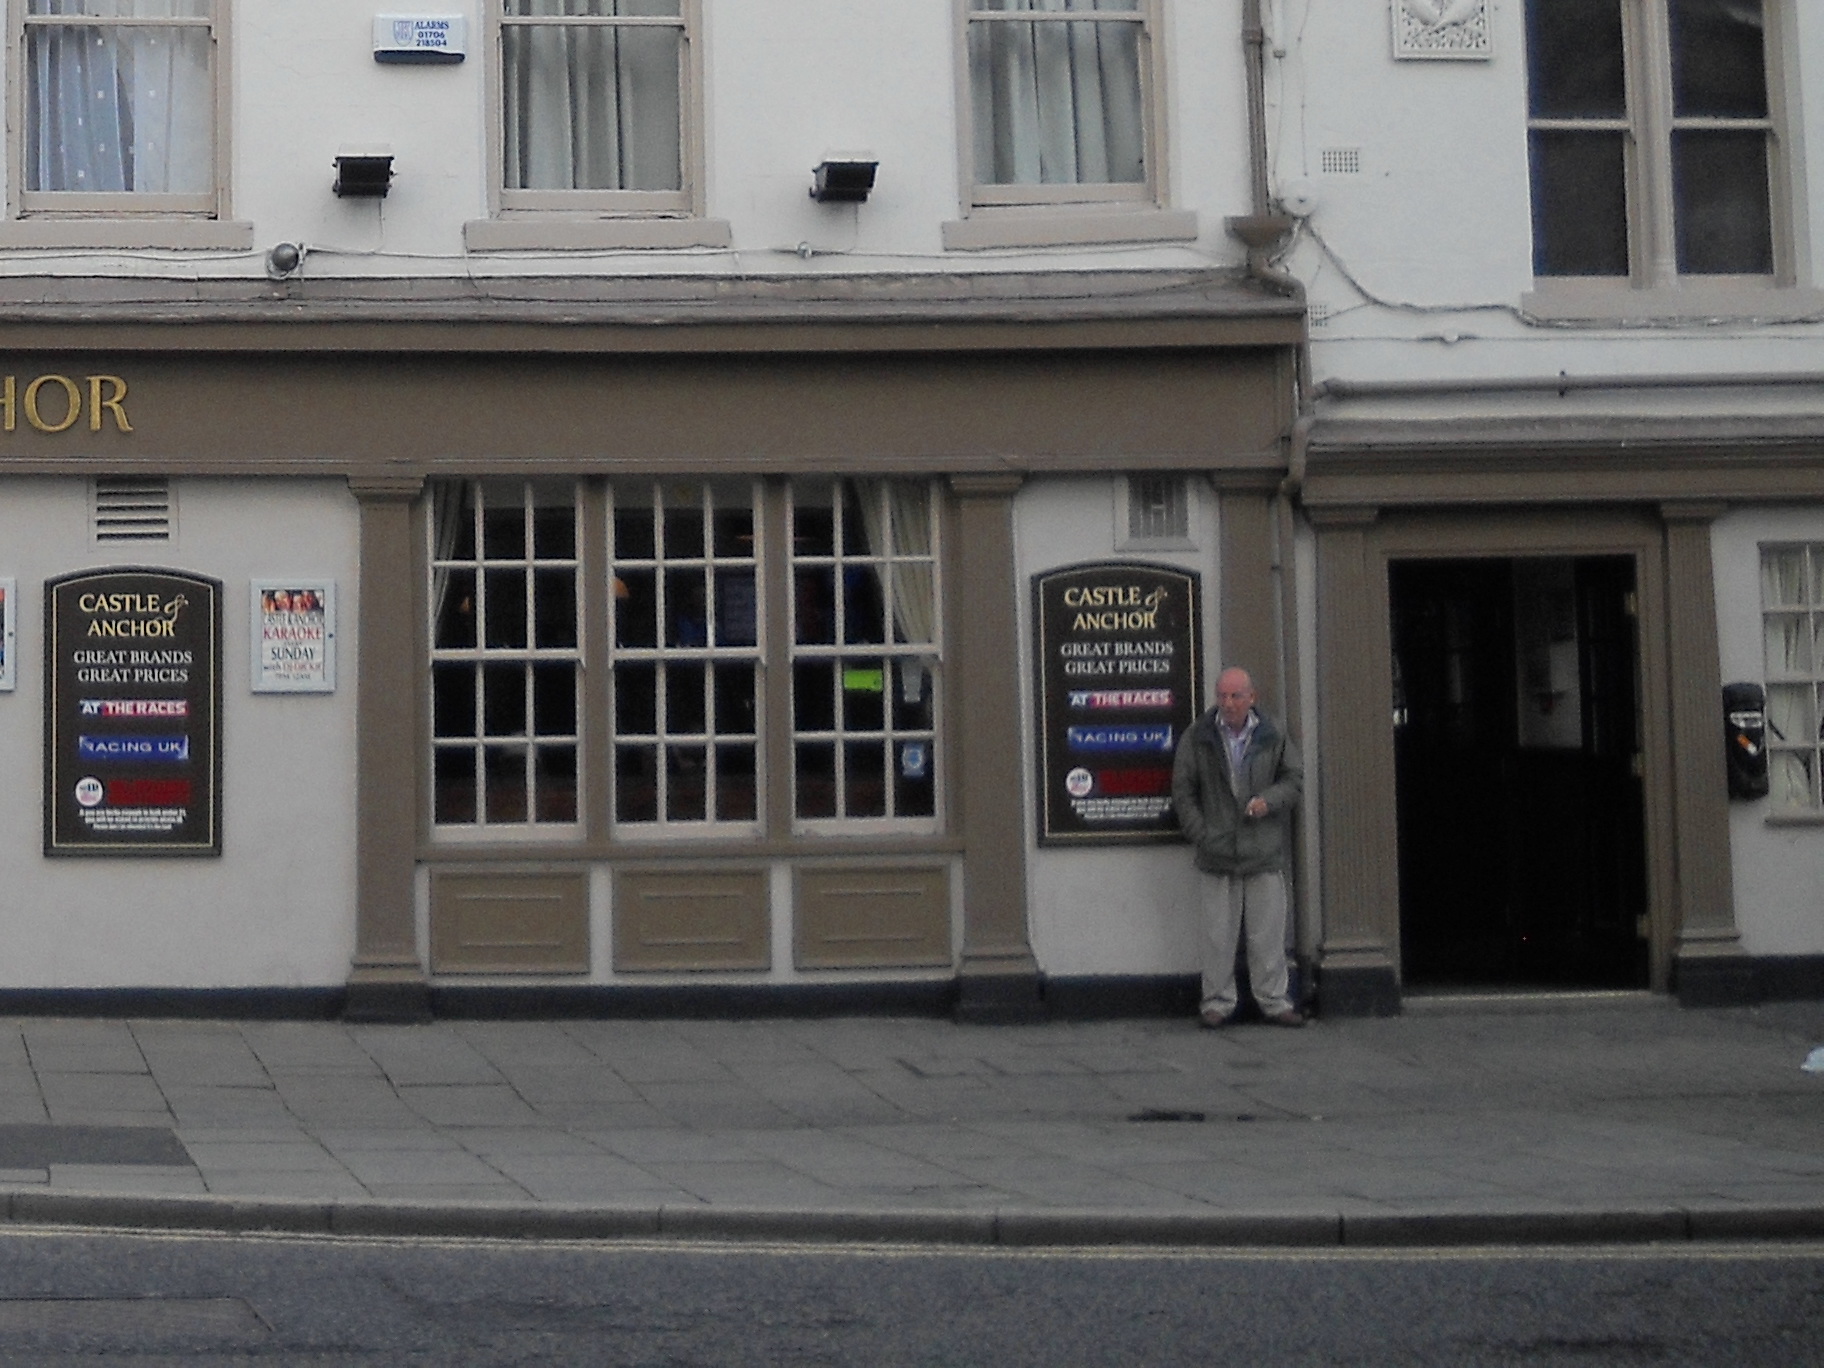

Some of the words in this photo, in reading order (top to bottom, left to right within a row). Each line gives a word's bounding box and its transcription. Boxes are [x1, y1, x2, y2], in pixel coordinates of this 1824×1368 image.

[415, 21, 449, 30] ALARMS
[418, 31, 445, 39] 01706
[1064, 586, 1141, 606] CASTLE
[1143, 585, 1168, 613] &
[79, 593, 160, 612] CASTLE
[162, 593, 189, 624] &
[87, 619, 175, 637] ANCHOR
[1073, 612, 1156, 630] ANCHOR
[263, 627, 321, 640] KARAOKE
[271, 647, 314, 660] SUNDAY
[1060, 642, 1111, 656] GREAT
[1114, 641, 1174, 655] BRANDS
[73, 650, 127, 664] GREAT
[130, 650, 193, 664] BRANDS
[1065, 660, 1116, 674] GREAT
[1118, 659, 1170, 674] PRICES
[78, 668, 131, 682] GREAT
[134, 668, 189, 682] PRICES
[1071, 694, 1089, 706] AT
[1095, 693, 1120, 706] THE
[1122, 691, 1170, 705] RACES
[82, 702, 101, 714] AT
[106, 702, 134, 714] THE
[136, 701, 186, 714] RACES
[1142, 731, 1164, 742] UK
[82, 741, 152, 752] RACING
[158, 742, 182, 752] UK
